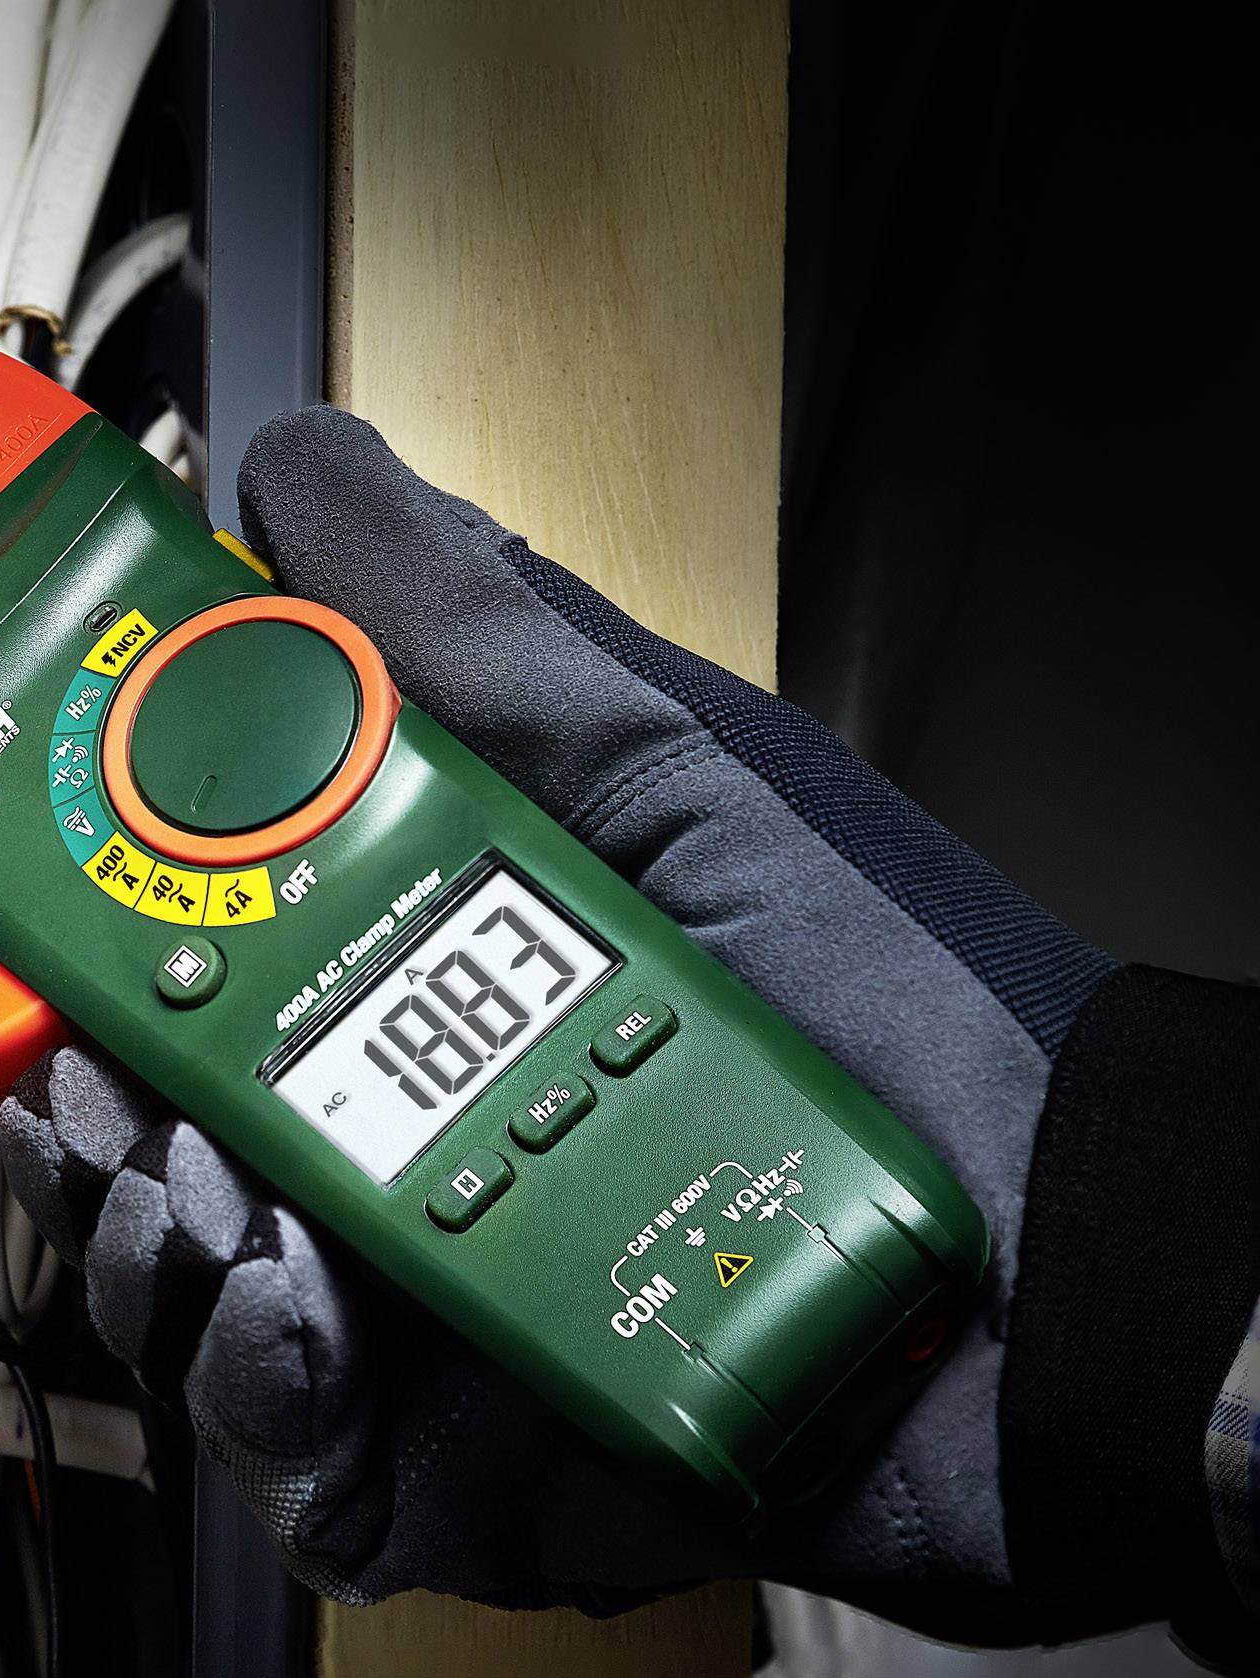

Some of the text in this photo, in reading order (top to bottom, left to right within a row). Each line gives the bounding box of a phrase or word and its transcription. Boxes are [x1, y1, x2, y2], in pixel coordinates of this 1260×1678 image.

[110, 623, 146, 659] NCV
[65, 685, 102, 720] Hz%
[95, 844, 140, 891] 400 A
[279, 858, 318, 905] OFF
[152, 874, 196, 913] 40 A
[275, 867, 442, 1032] 400A AC Clamp Meter
[404, 968, 424, 986] A
[615, 1011, 651, 1041] REL
[322, 1091, 347, 1118] AC
[528, 1084, 571, 1124] Hz%
[626, 1174, 711, 1257] CAT III 600V
[610, 1273, 678, 1339] COM
